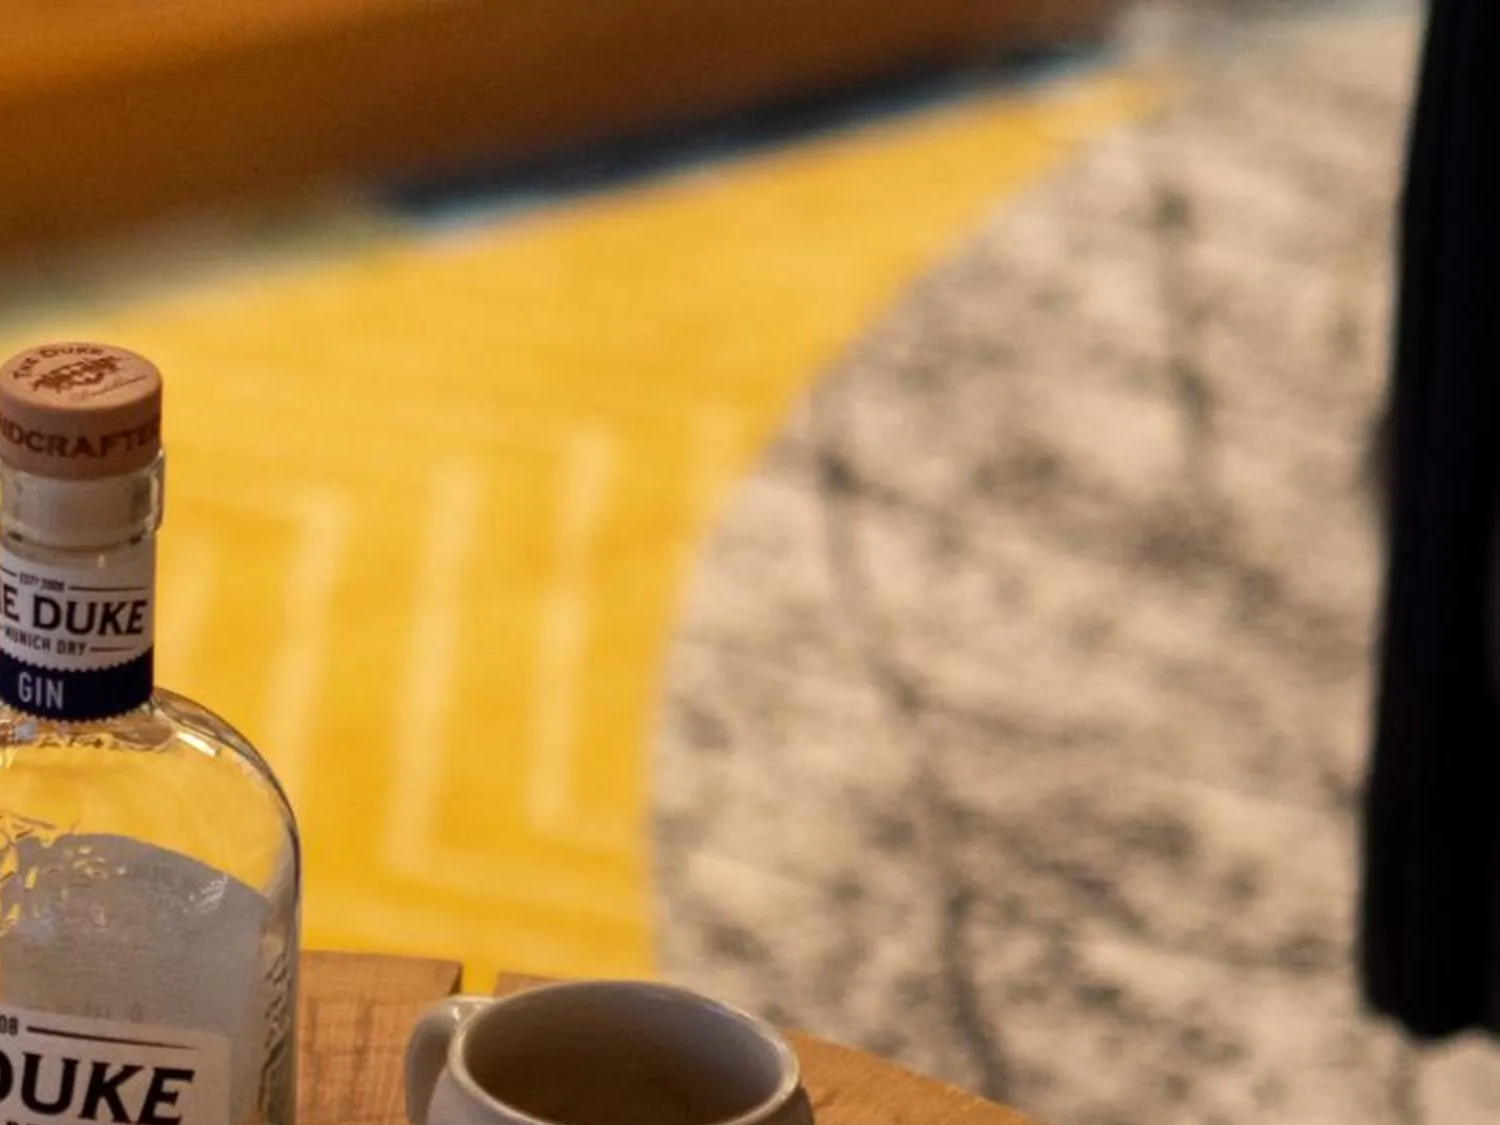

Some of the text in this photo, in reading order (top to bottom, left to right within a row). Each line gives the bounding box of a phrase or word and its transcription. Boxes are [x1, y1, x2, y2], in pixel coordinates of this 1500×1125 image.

[32, 593, 149, 636] DUKE
[4, 628, 88, 657] MUNICH DRY
[18, 671, 64, 710] GIN
